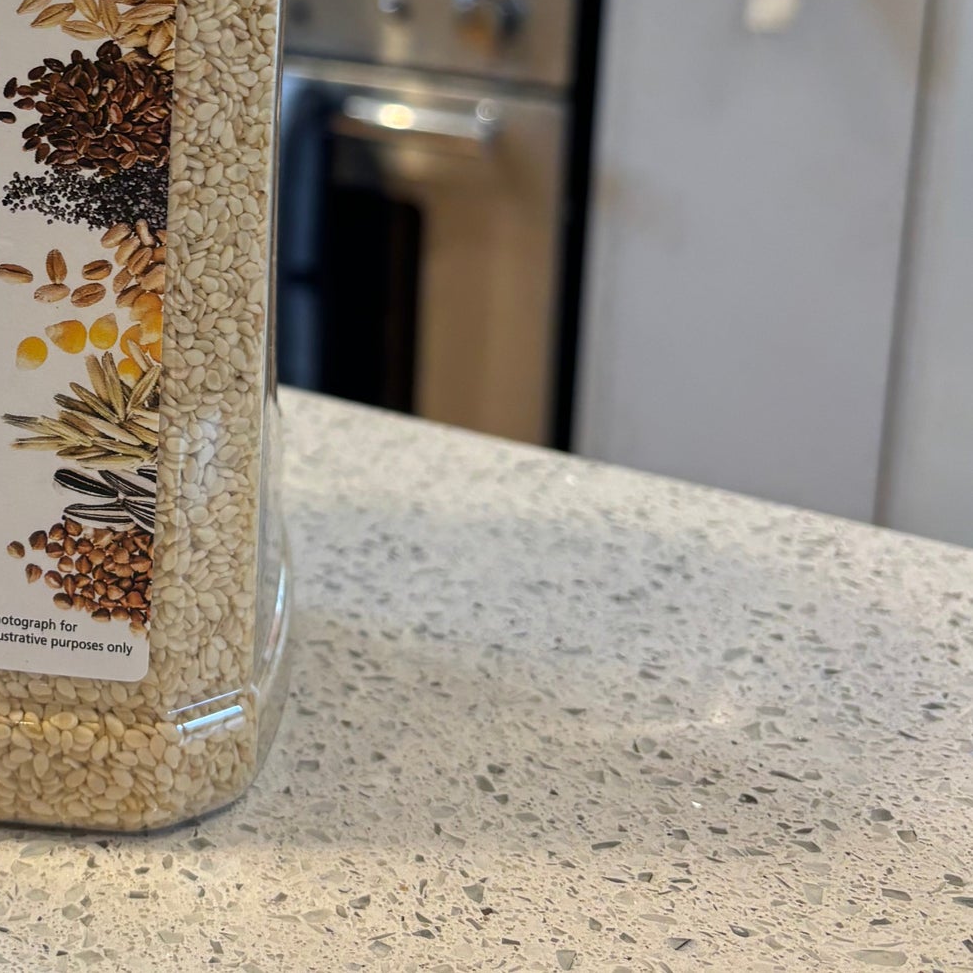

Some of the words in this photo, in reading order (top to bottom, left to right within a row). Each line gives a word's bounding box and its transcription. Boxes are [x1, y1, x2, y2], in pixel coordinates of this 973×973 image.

[59, 619, 78, 633] for
[50, 638, 105, 654] purposes
[107, 642, 134, 656] only
